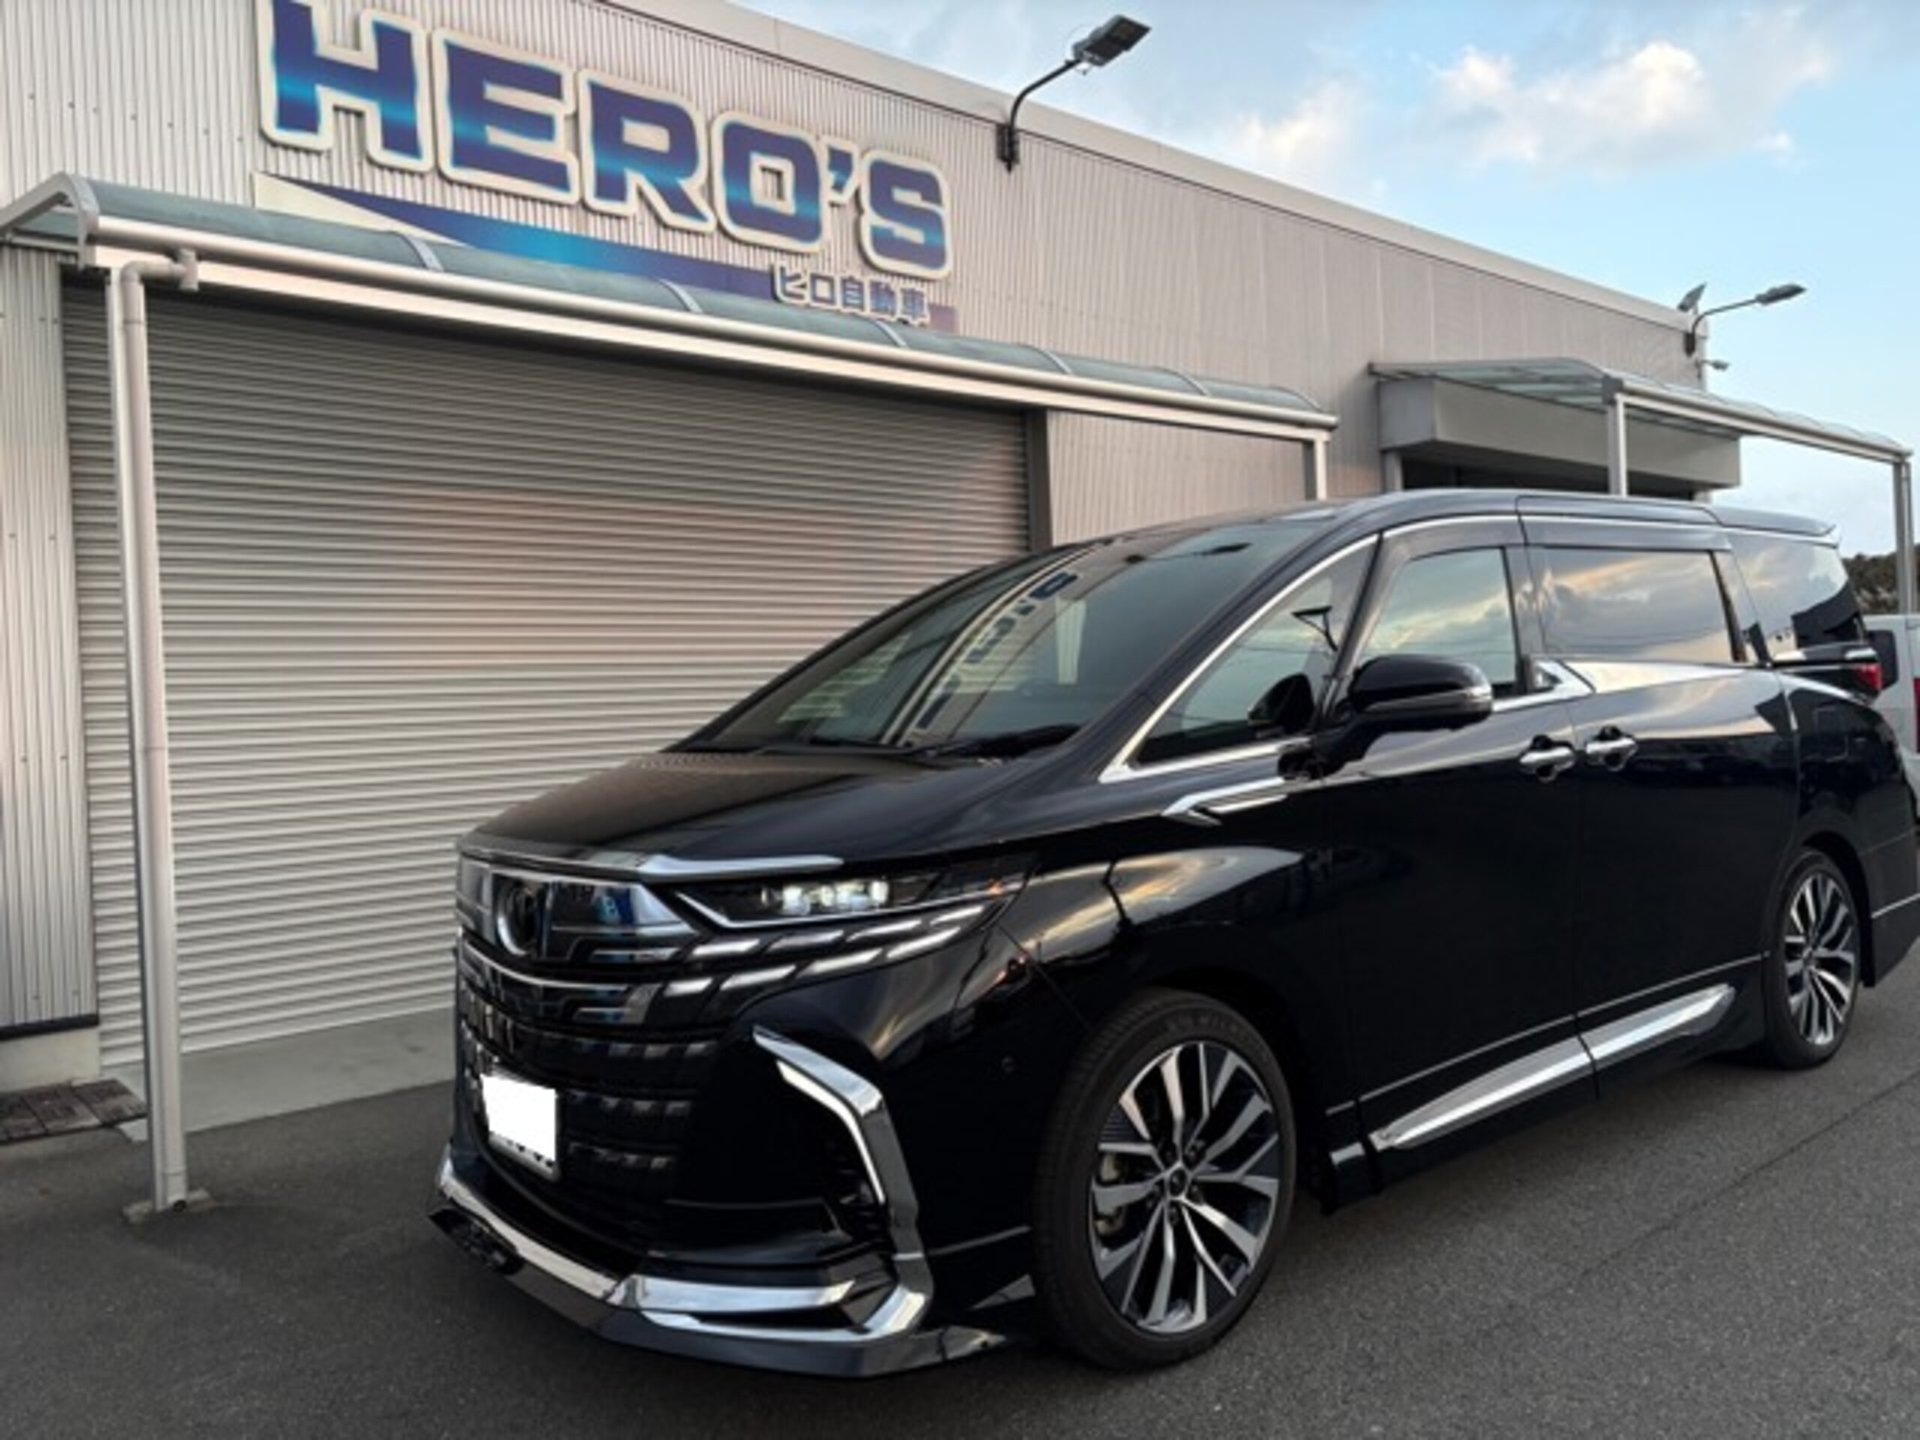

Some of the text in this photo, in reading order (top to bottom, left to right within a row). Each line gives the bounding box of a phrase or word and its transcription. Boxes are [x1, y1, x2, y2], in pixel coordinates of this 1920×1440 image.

[268, 0, 949, 272] HERO'S
[778, 264, 930, 322] ヒロ自動車
